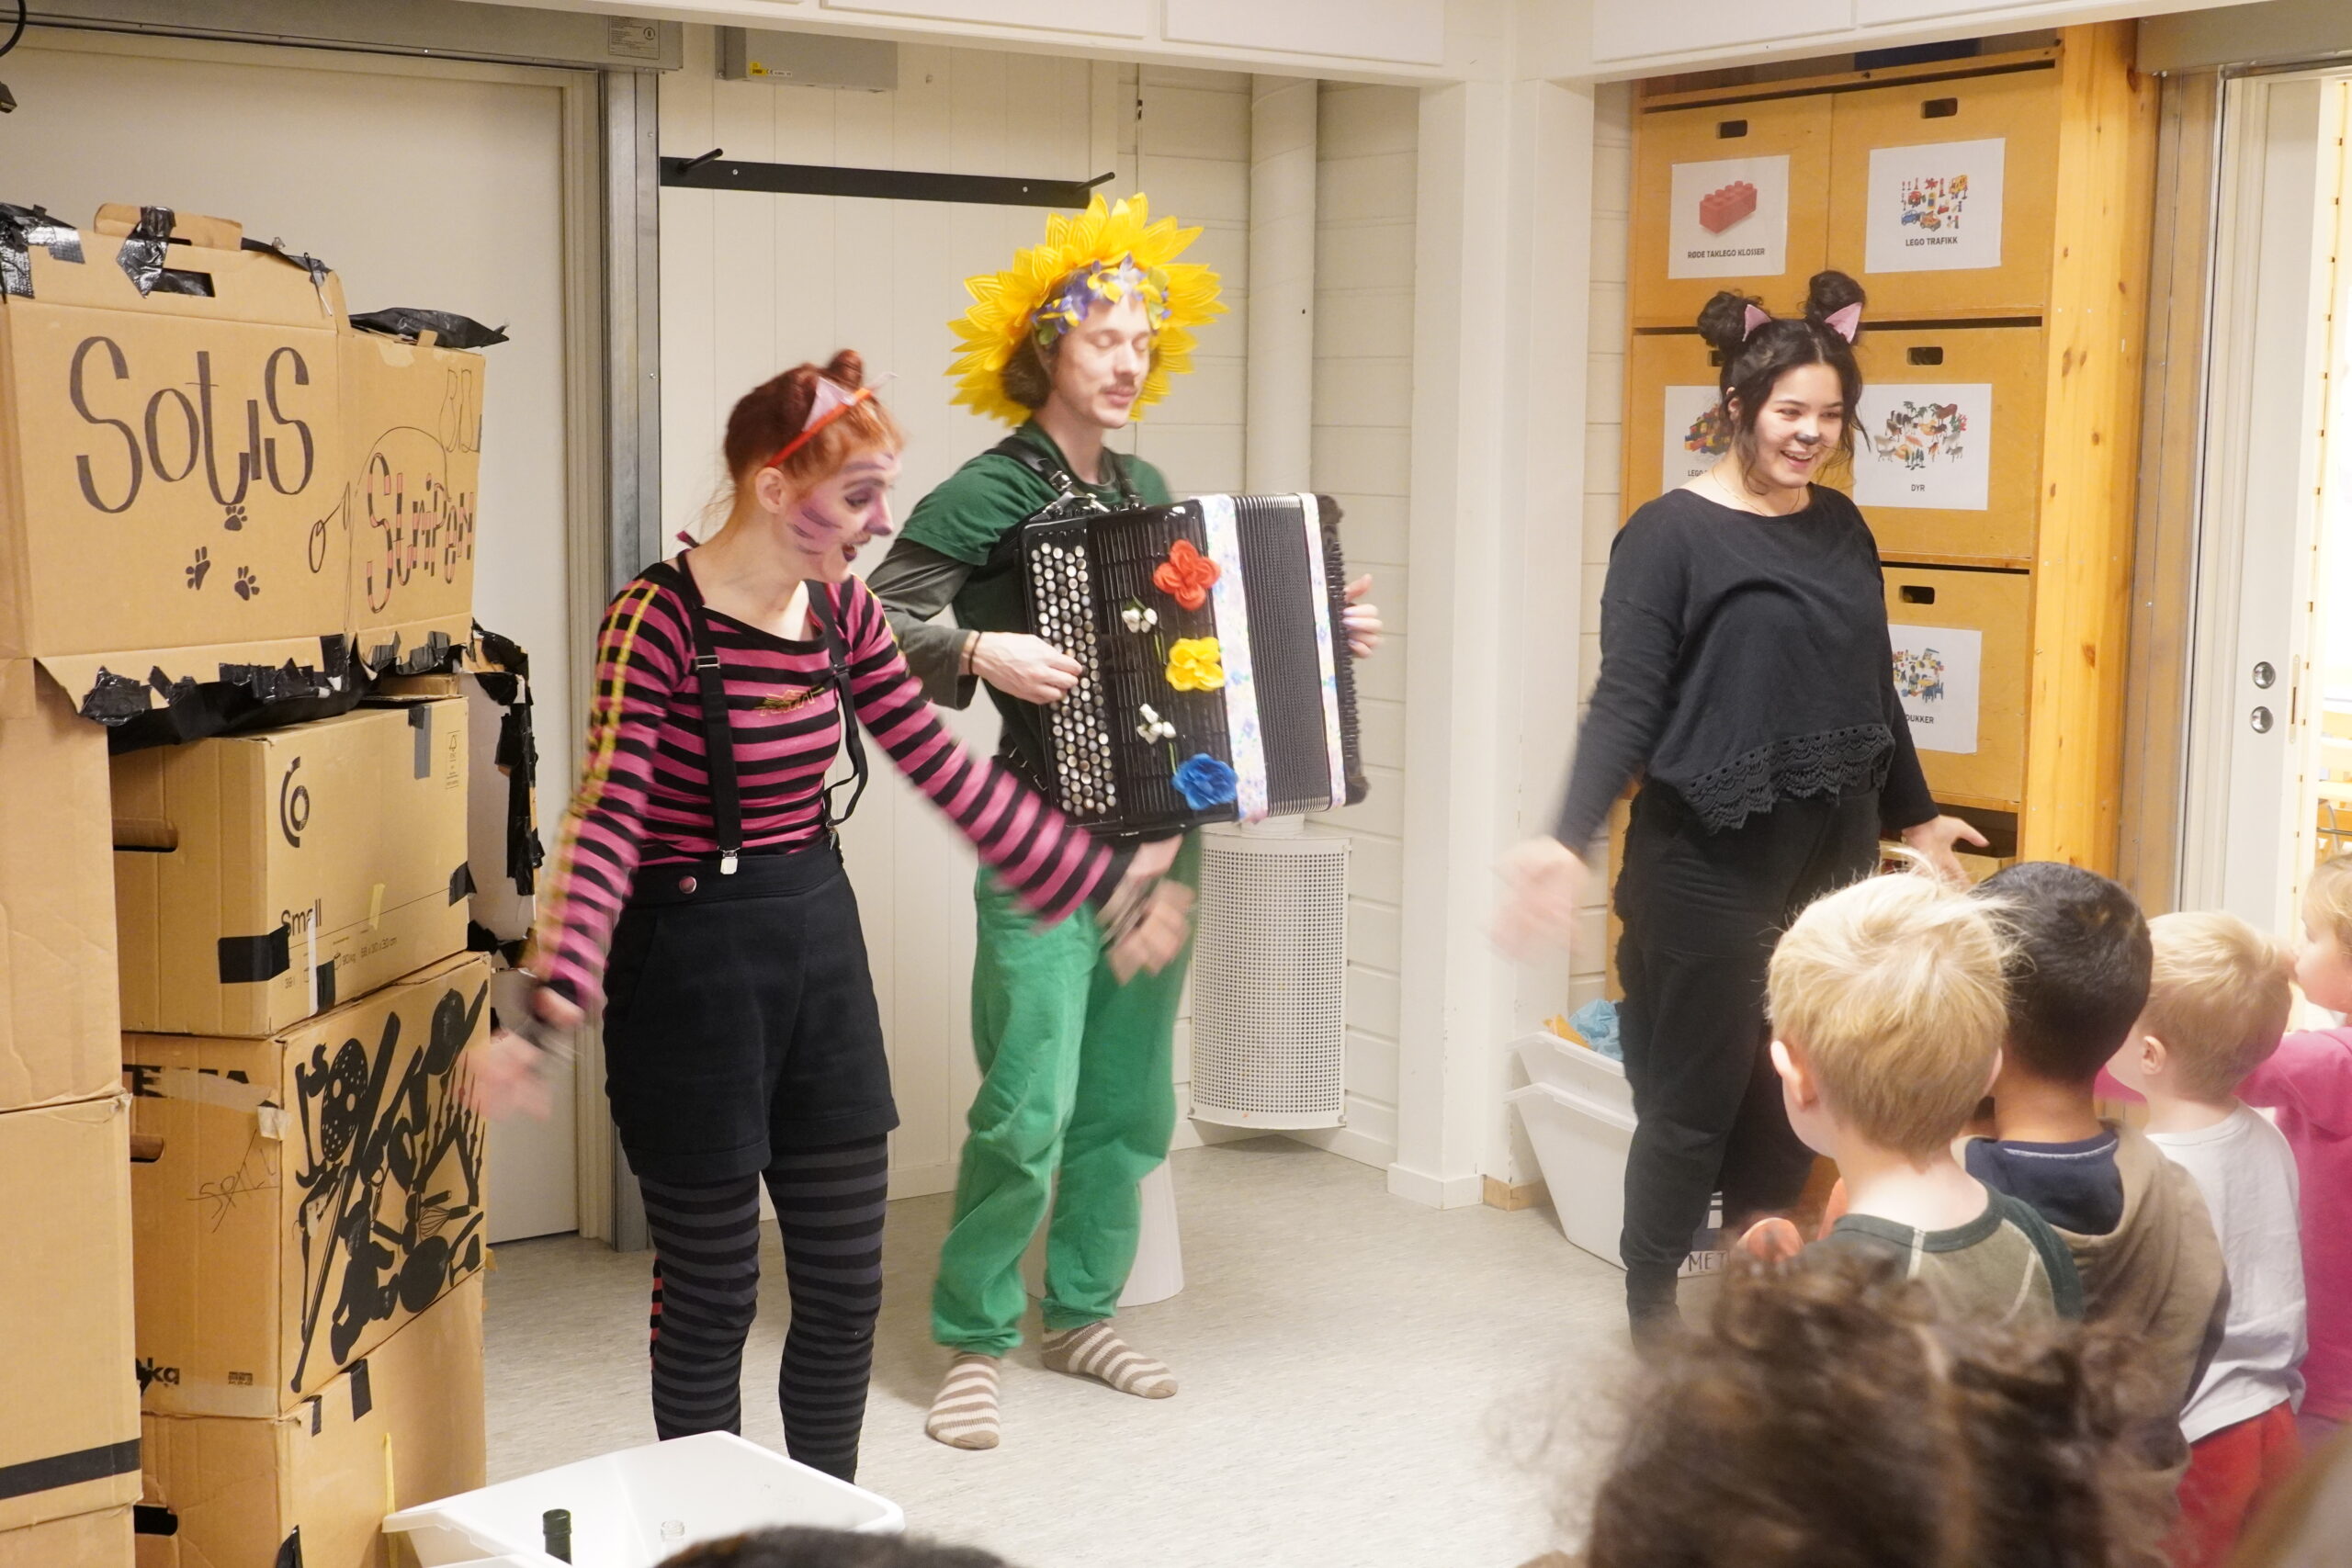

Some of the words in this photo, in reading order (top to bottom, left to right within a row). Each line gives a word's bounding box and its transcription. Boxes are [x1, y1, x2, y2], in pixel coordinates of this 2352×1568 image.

[1905, 238, 1925, 246] LEGO
[1927, 236, 1958, 245] TRAFIKK
[1738, 247, 1765, 256] KLOSSER
